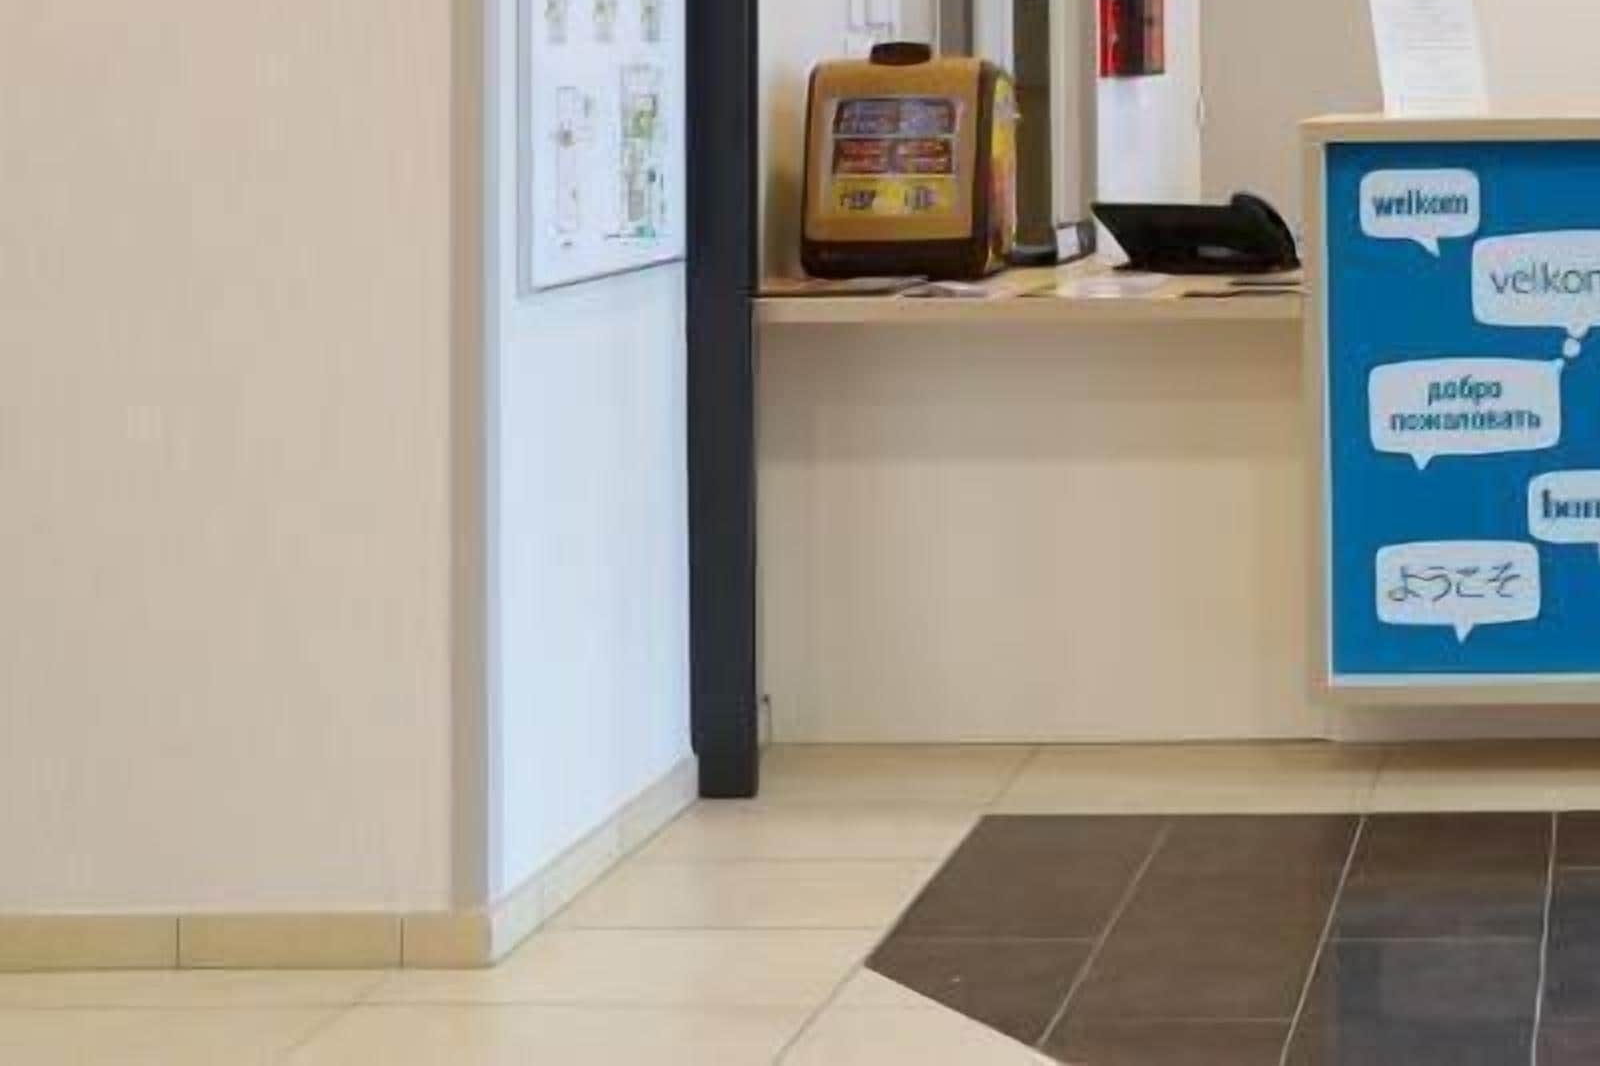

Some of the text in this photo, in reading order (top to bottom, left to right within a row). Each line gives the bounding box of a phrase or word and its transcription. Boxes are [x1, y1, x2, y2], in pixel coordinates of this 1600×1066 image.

[1373, 189, 1468, 218] welkom
[1387, 561, 1521, 602] ようこそ
